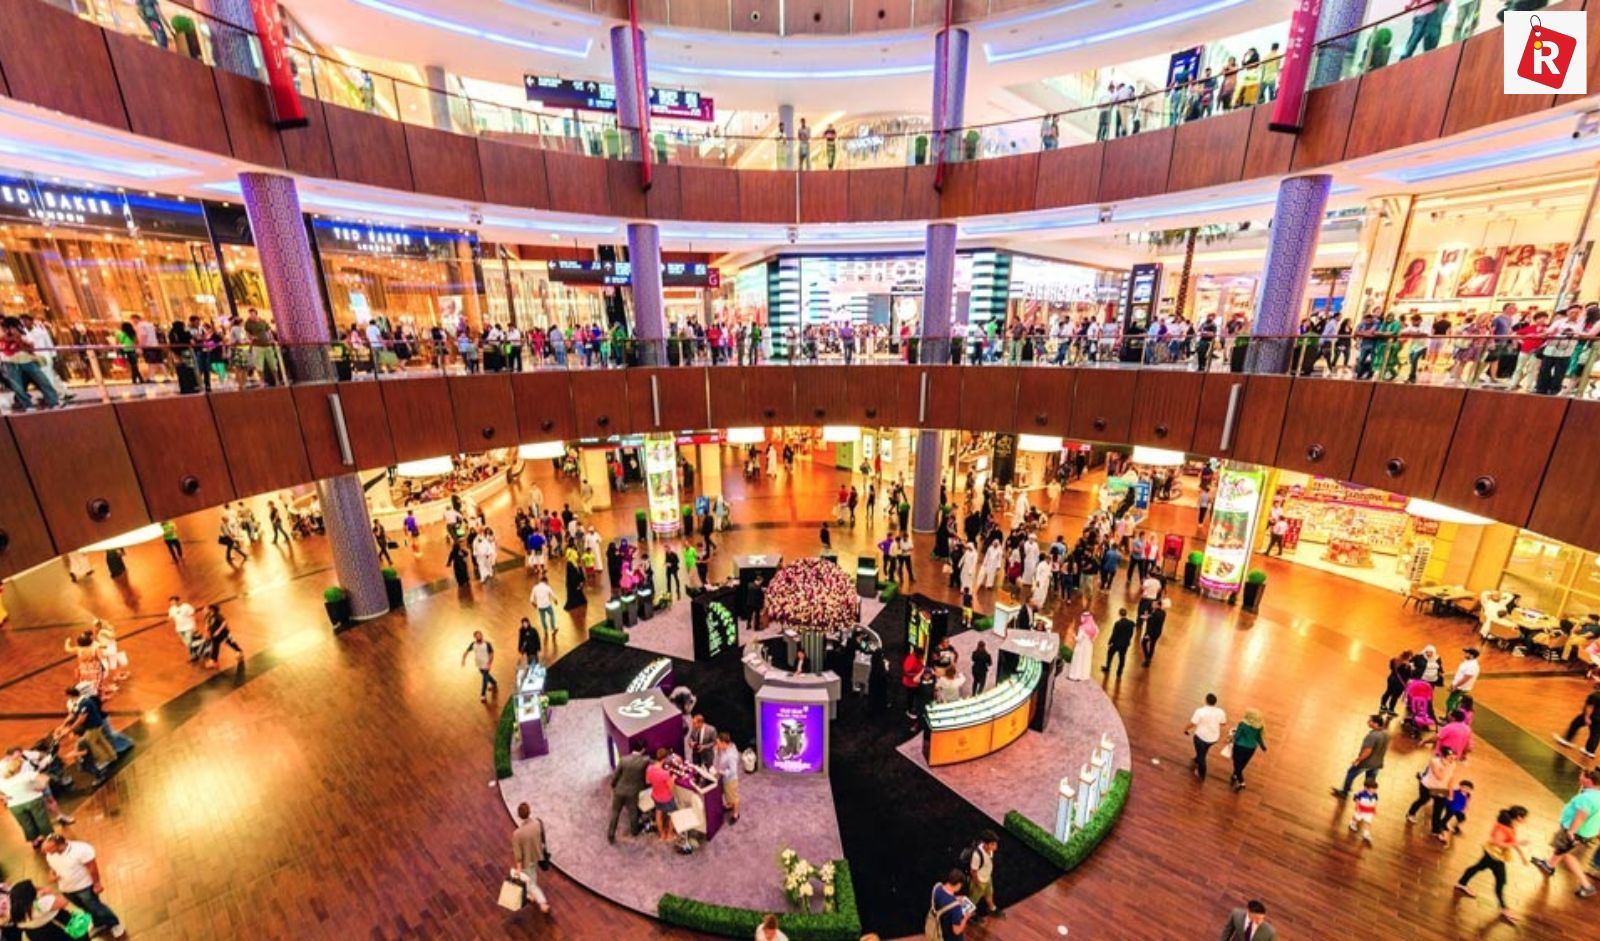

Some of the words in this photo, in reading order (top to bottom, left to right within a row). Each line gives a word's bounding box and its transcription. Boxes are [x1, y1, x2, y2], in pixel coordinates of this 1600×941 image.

[44, 192, 112, 215] BAKER
[28, 208, 84, 223] LONDON
[334, 226, 359, 242] TED
[709, 274, 718, 286] G
